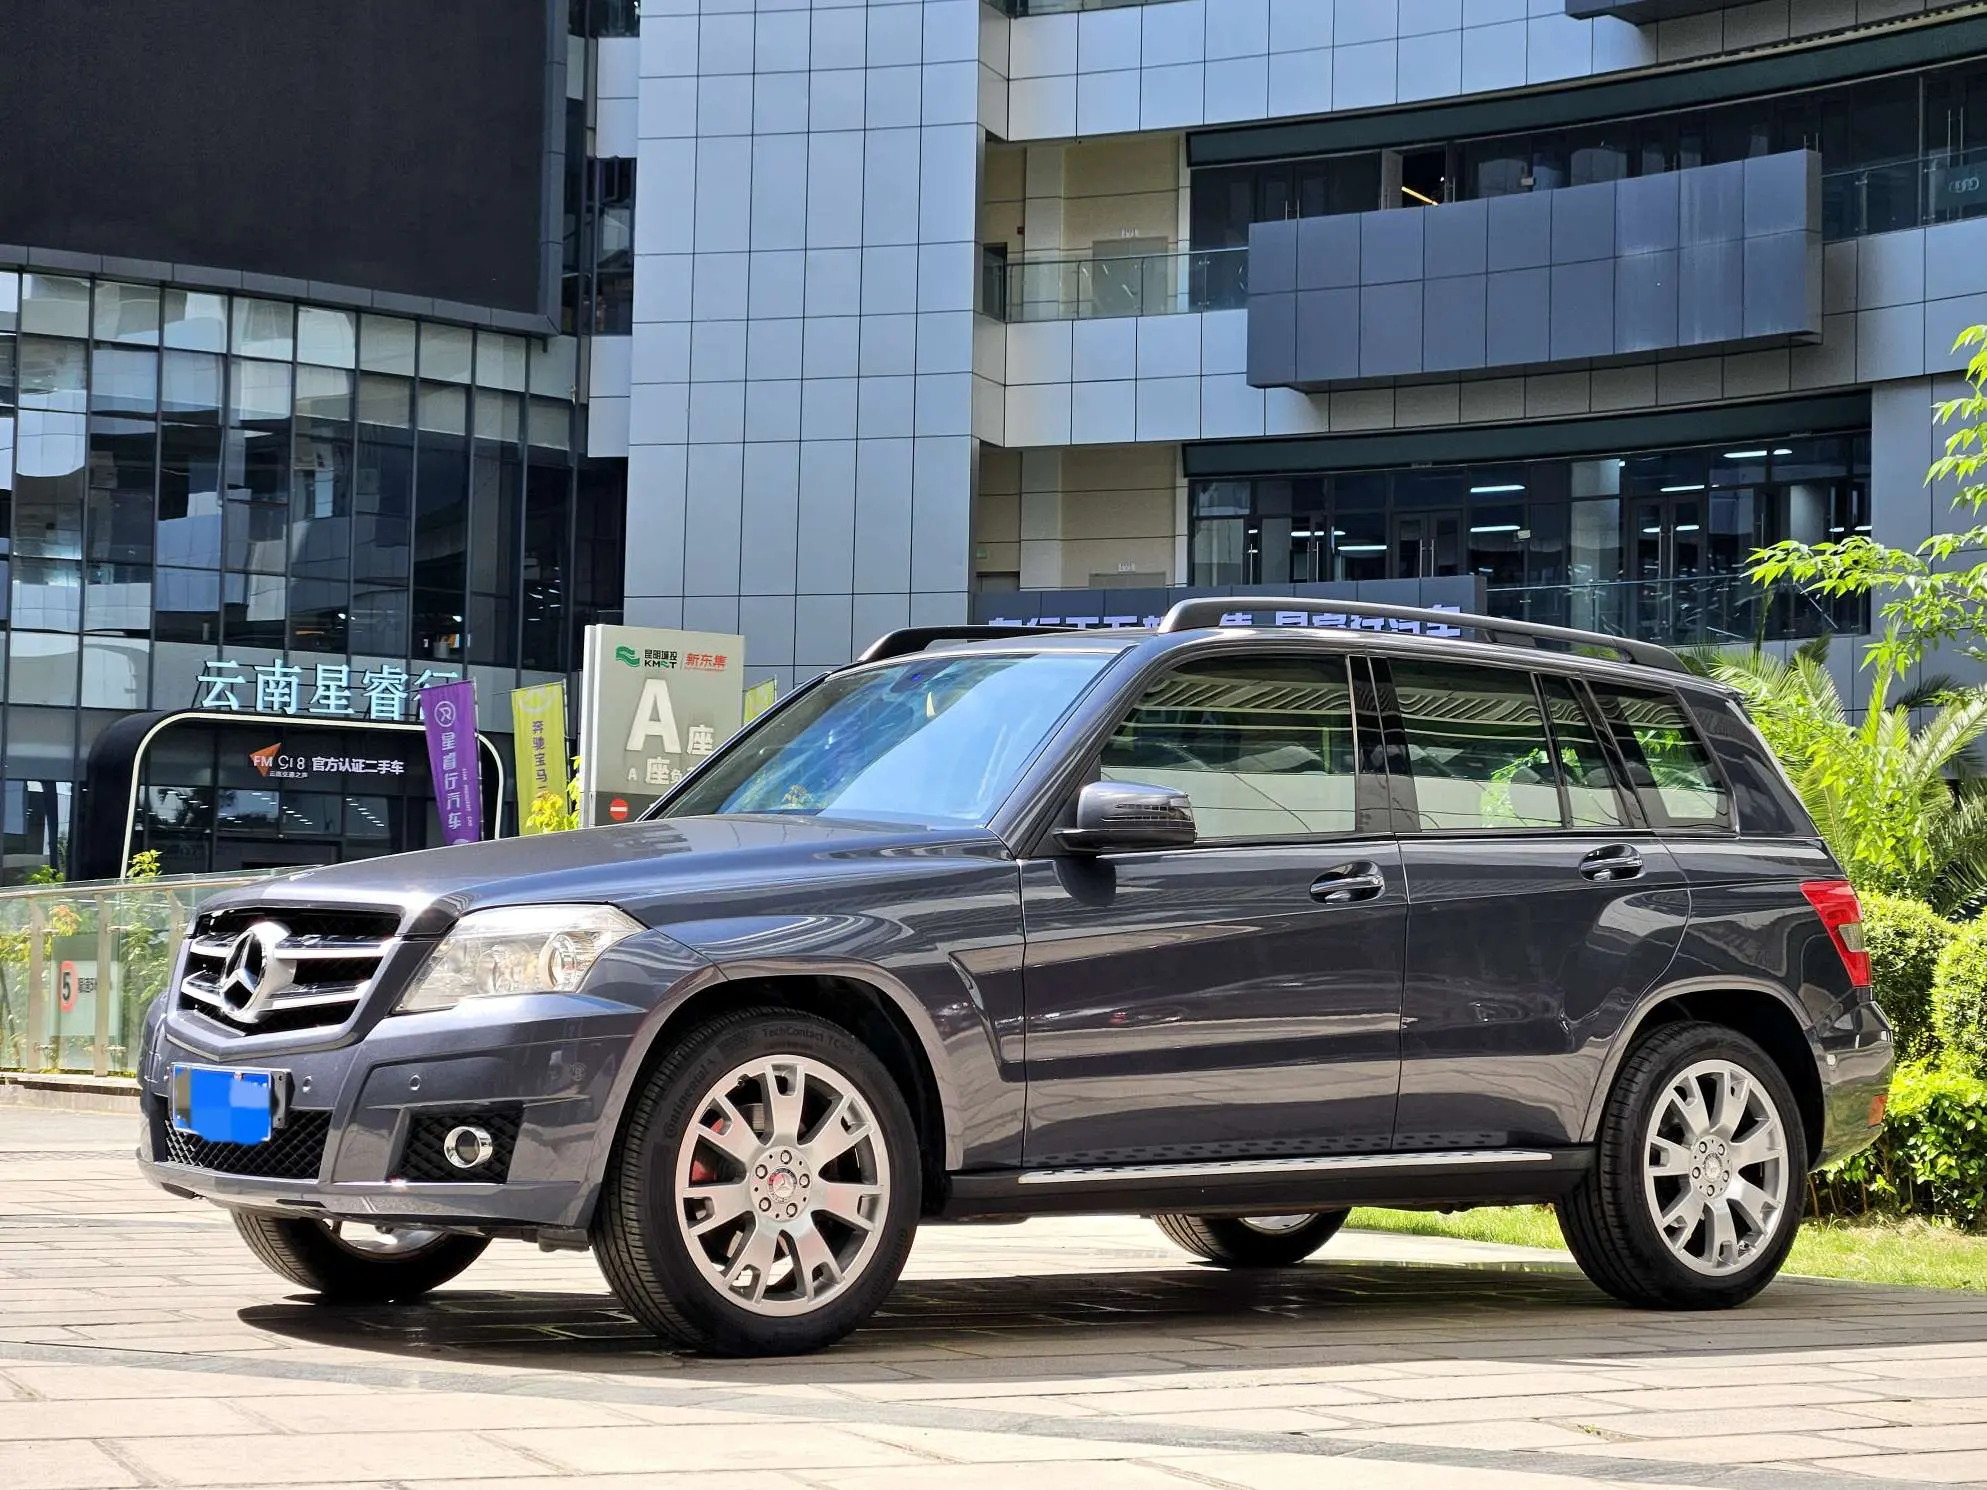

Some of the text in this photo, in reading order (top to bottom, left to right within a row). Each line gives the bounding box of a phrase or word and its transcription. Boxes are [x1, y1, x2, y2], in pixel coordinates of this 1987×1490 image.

[253, 756, 273, 768] FM
[312, 756, 405, 775] 官方认证二手车
[62, 971, 71, 1001] 5
